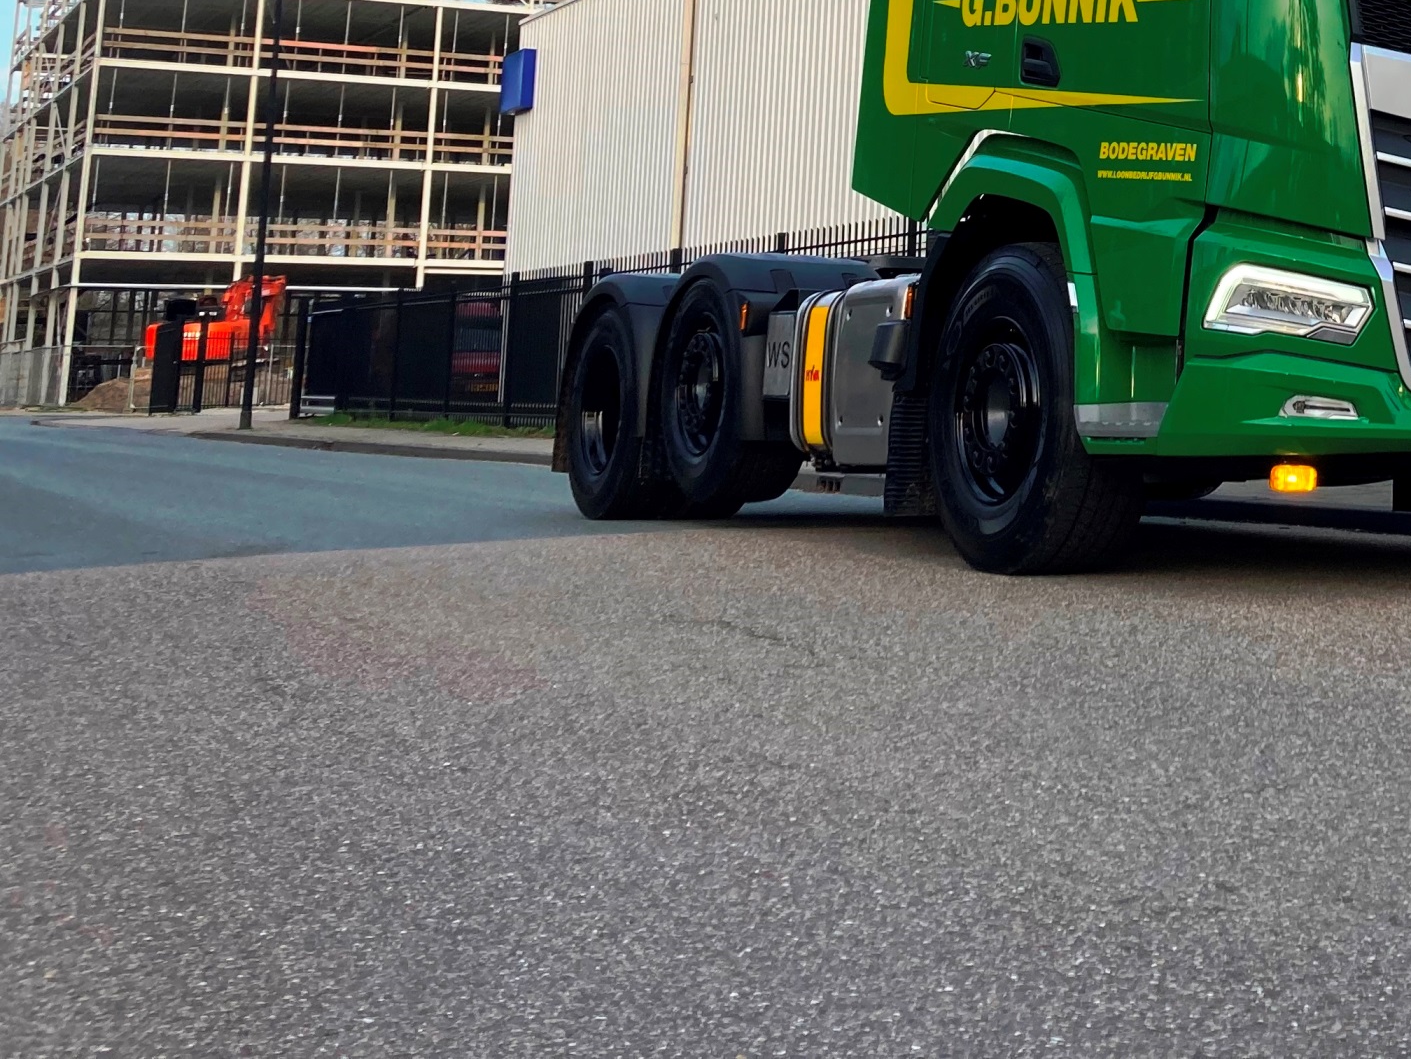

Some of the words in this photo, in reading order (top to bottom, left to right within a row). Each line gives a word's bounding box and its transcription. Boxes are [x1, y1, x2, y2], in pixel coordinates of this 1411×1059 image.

[963, 50, 993, 69] XF
[1099, 141, 1198, 162] BODEGRAVEN
[767, 341, 790, 368] WS
